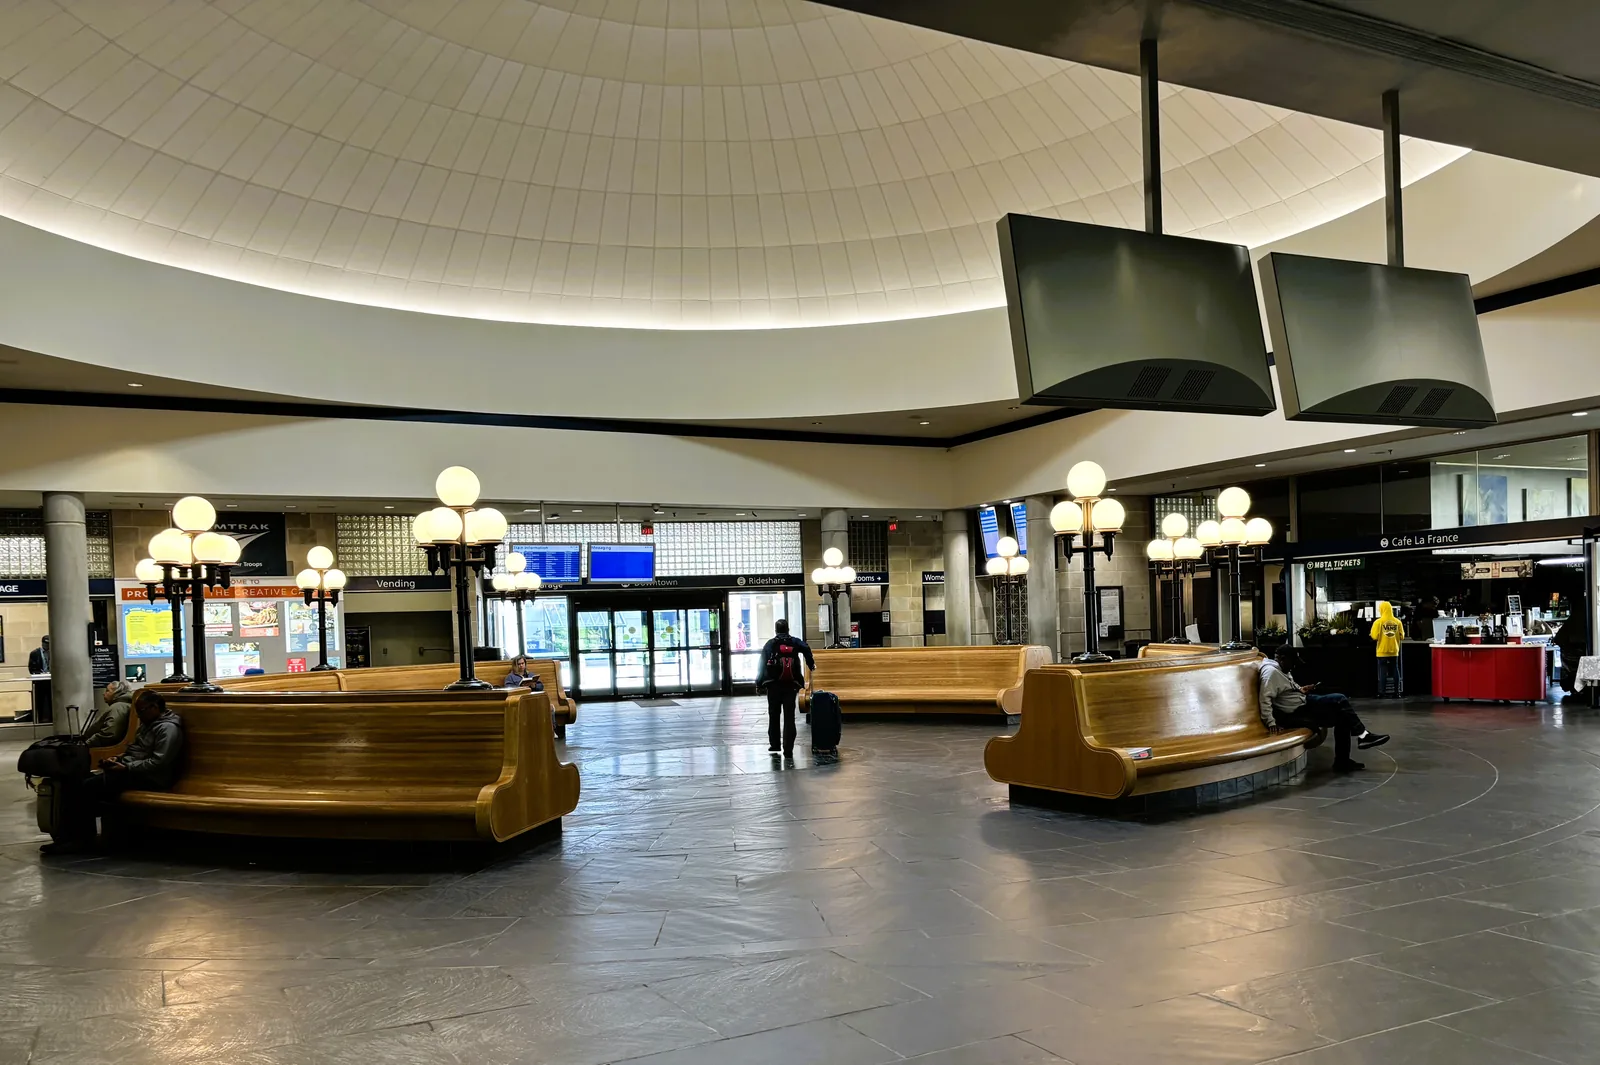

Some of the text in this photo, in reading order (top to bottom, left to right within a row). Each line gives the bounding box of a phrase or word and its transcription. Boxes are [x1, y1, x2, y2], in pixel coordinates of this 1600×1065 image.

[1391, 534, 1459, 547] Cafe La France
[1314, 561, 1332, 569] MBTA
[1333, 559, 1361, 568] TICKETS
[376, 579, 416, 589] Vending
[748, 576, 786, 585] Rideshare
[0, 584, 19, 593] AGE
[235, 587, 287, 596] CREATIVE
